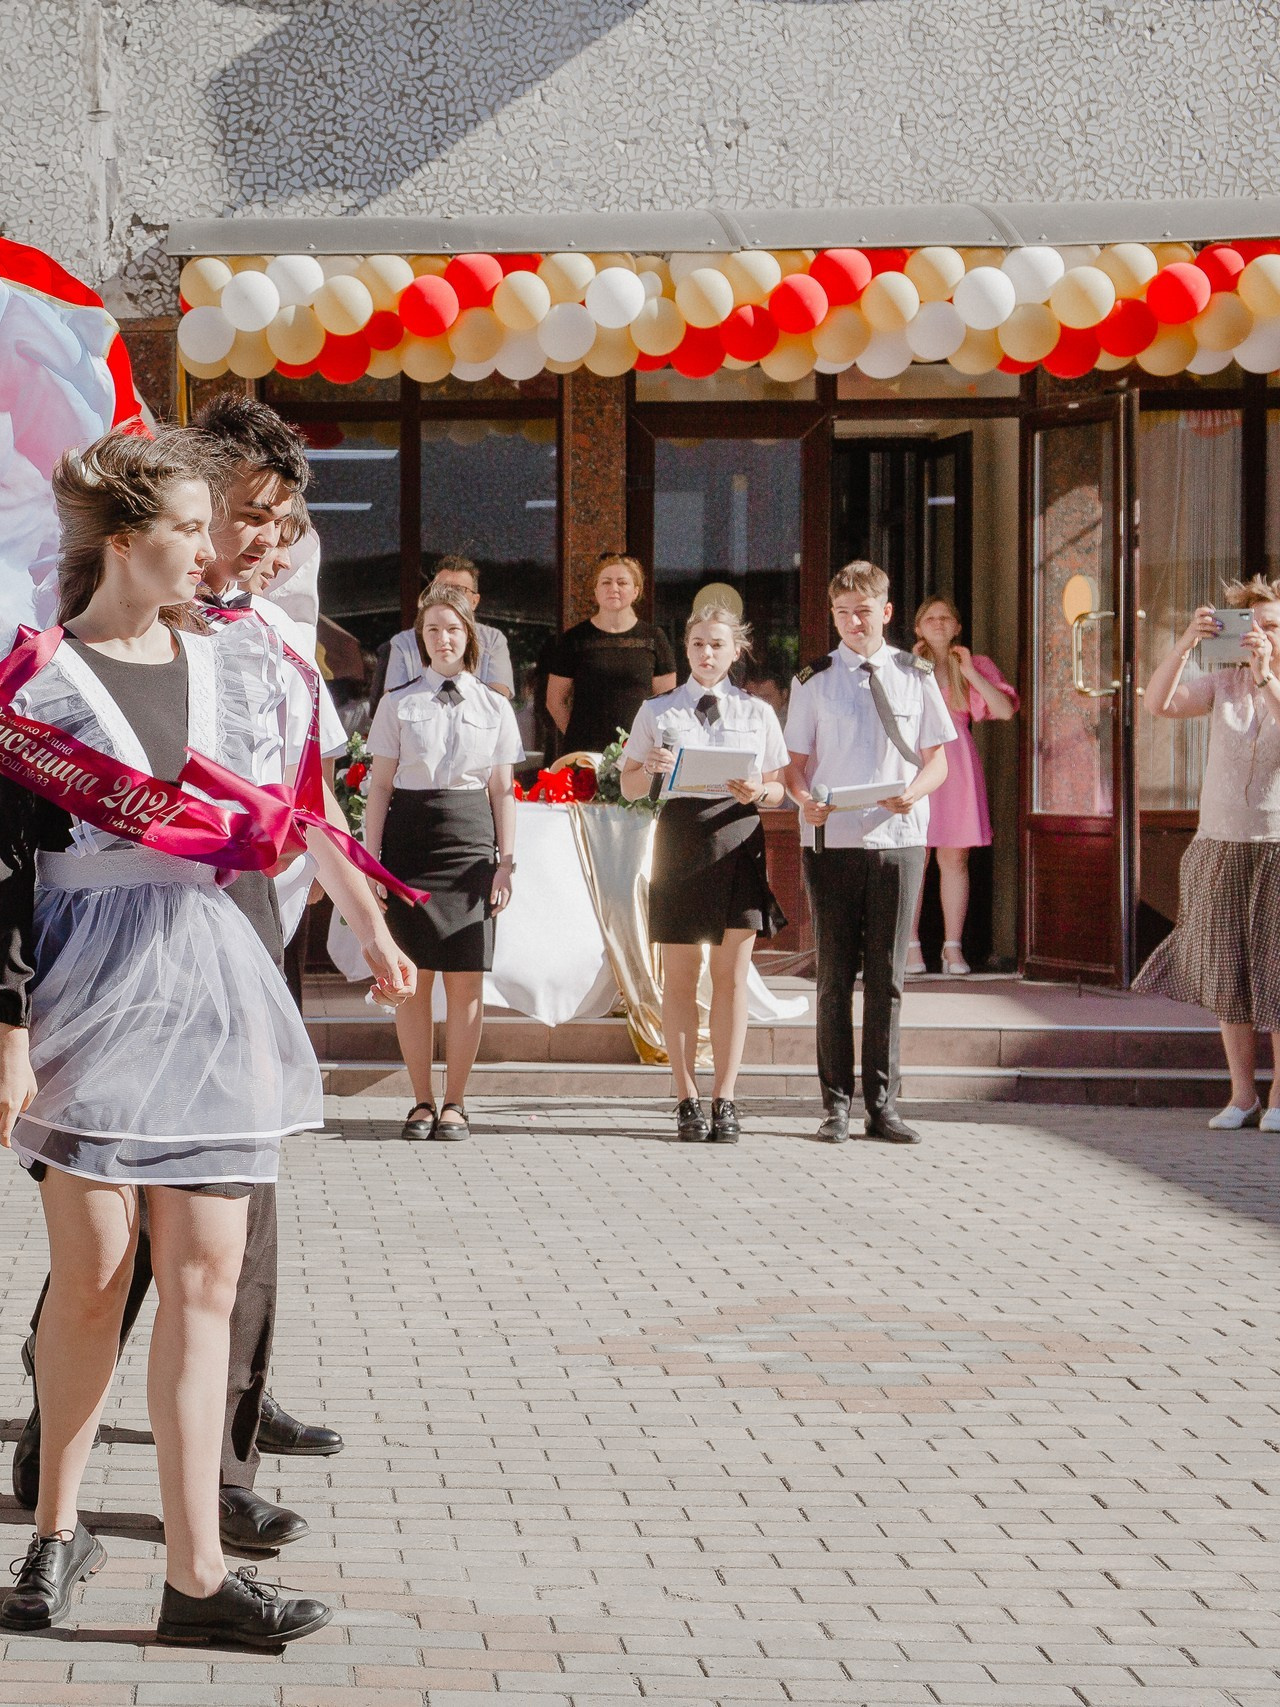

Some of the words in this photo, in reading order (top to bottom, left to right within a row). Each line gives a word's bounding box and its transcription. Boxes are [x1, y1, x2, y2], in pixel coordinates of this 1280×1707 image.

[41, 731, 74, 756] Алина
[22, 768, 50, 787] №33
[97, 775, 188, 828] 2024
